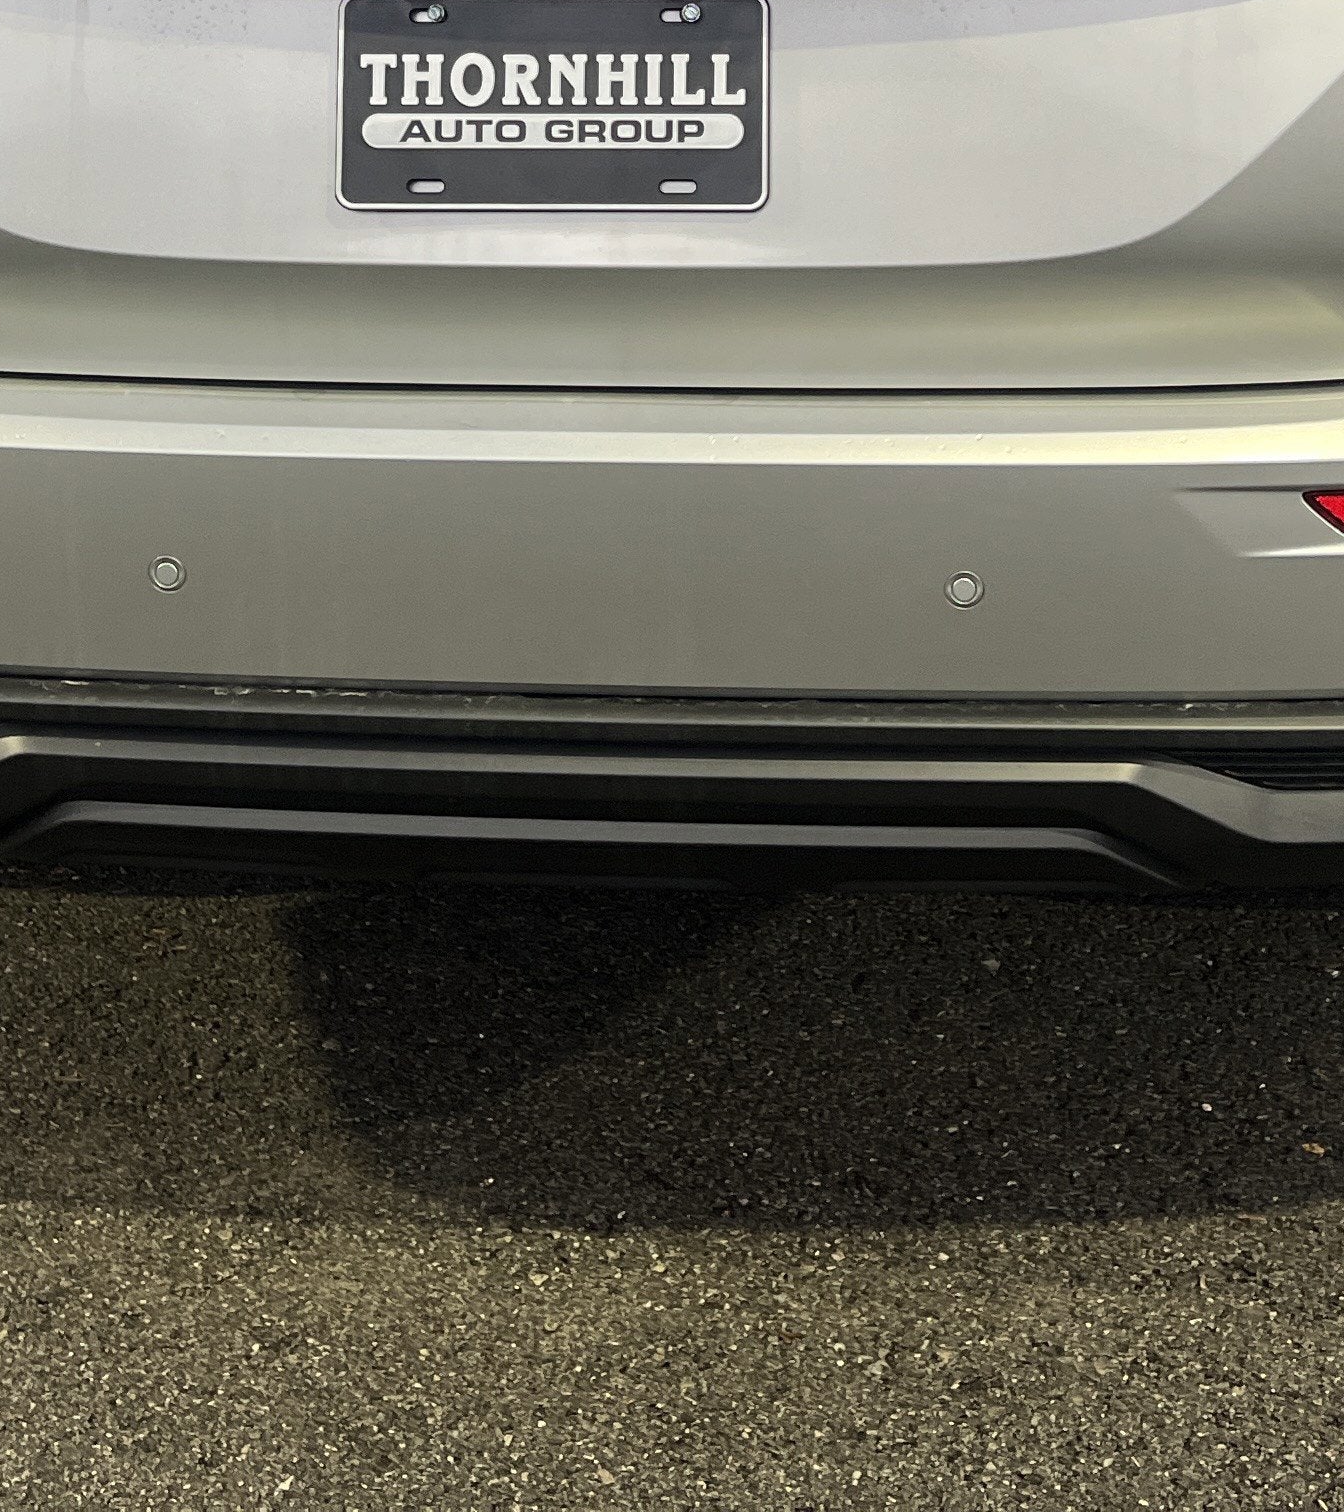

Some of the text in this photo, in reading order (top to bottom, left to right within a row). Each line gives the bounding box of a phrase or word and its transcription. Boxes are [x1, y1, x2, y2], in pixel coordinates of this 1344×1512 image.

[359, 52, 747, 108] THORNHILL
[399, 119, 705, 143] AUTO GROUP
